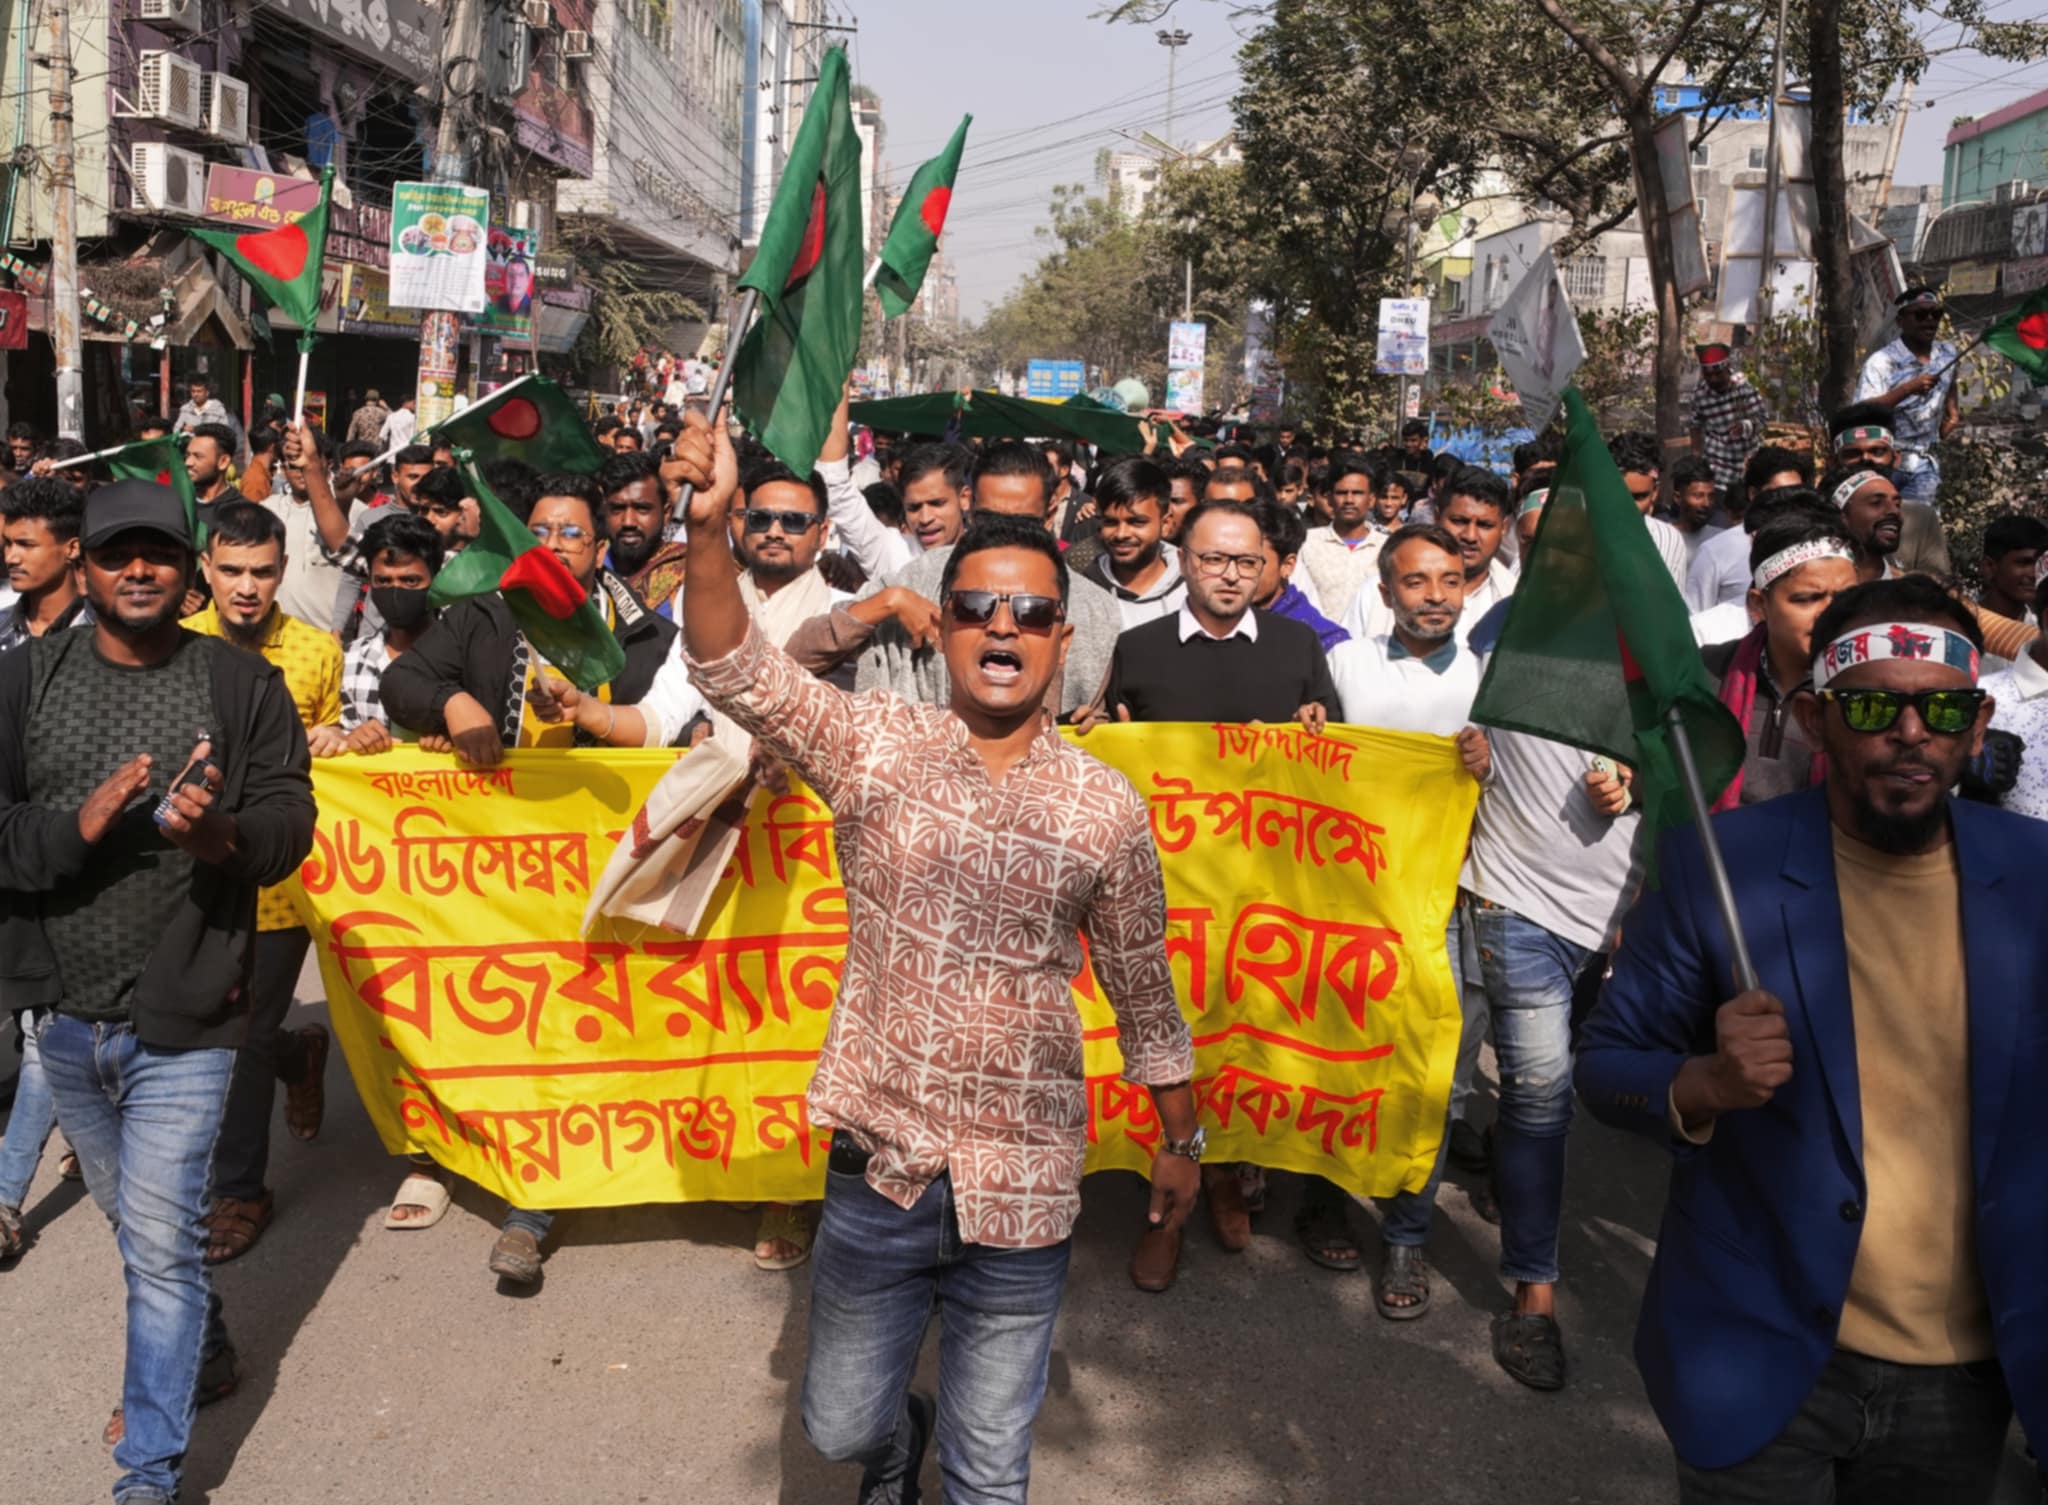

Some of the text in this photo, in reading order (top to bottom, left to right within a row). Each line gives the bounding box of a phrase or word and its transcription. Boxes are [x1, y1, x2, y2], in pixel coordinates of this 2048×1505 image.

[535, 266, 567, 279] SUNG
[363, 767, 515, 801] বাংলাদেশ
[301, 819, 385, 895] ১৬
[391, 805, 590, 897] ডিসেম্বর
[1149, 772, 1388, 886] উপলক্ষে
[329, 911, 638, 1049] বিজয়
[1225, 902, 1403, 1031] হোক
[1296, 1084, 1385, 1158] দল
